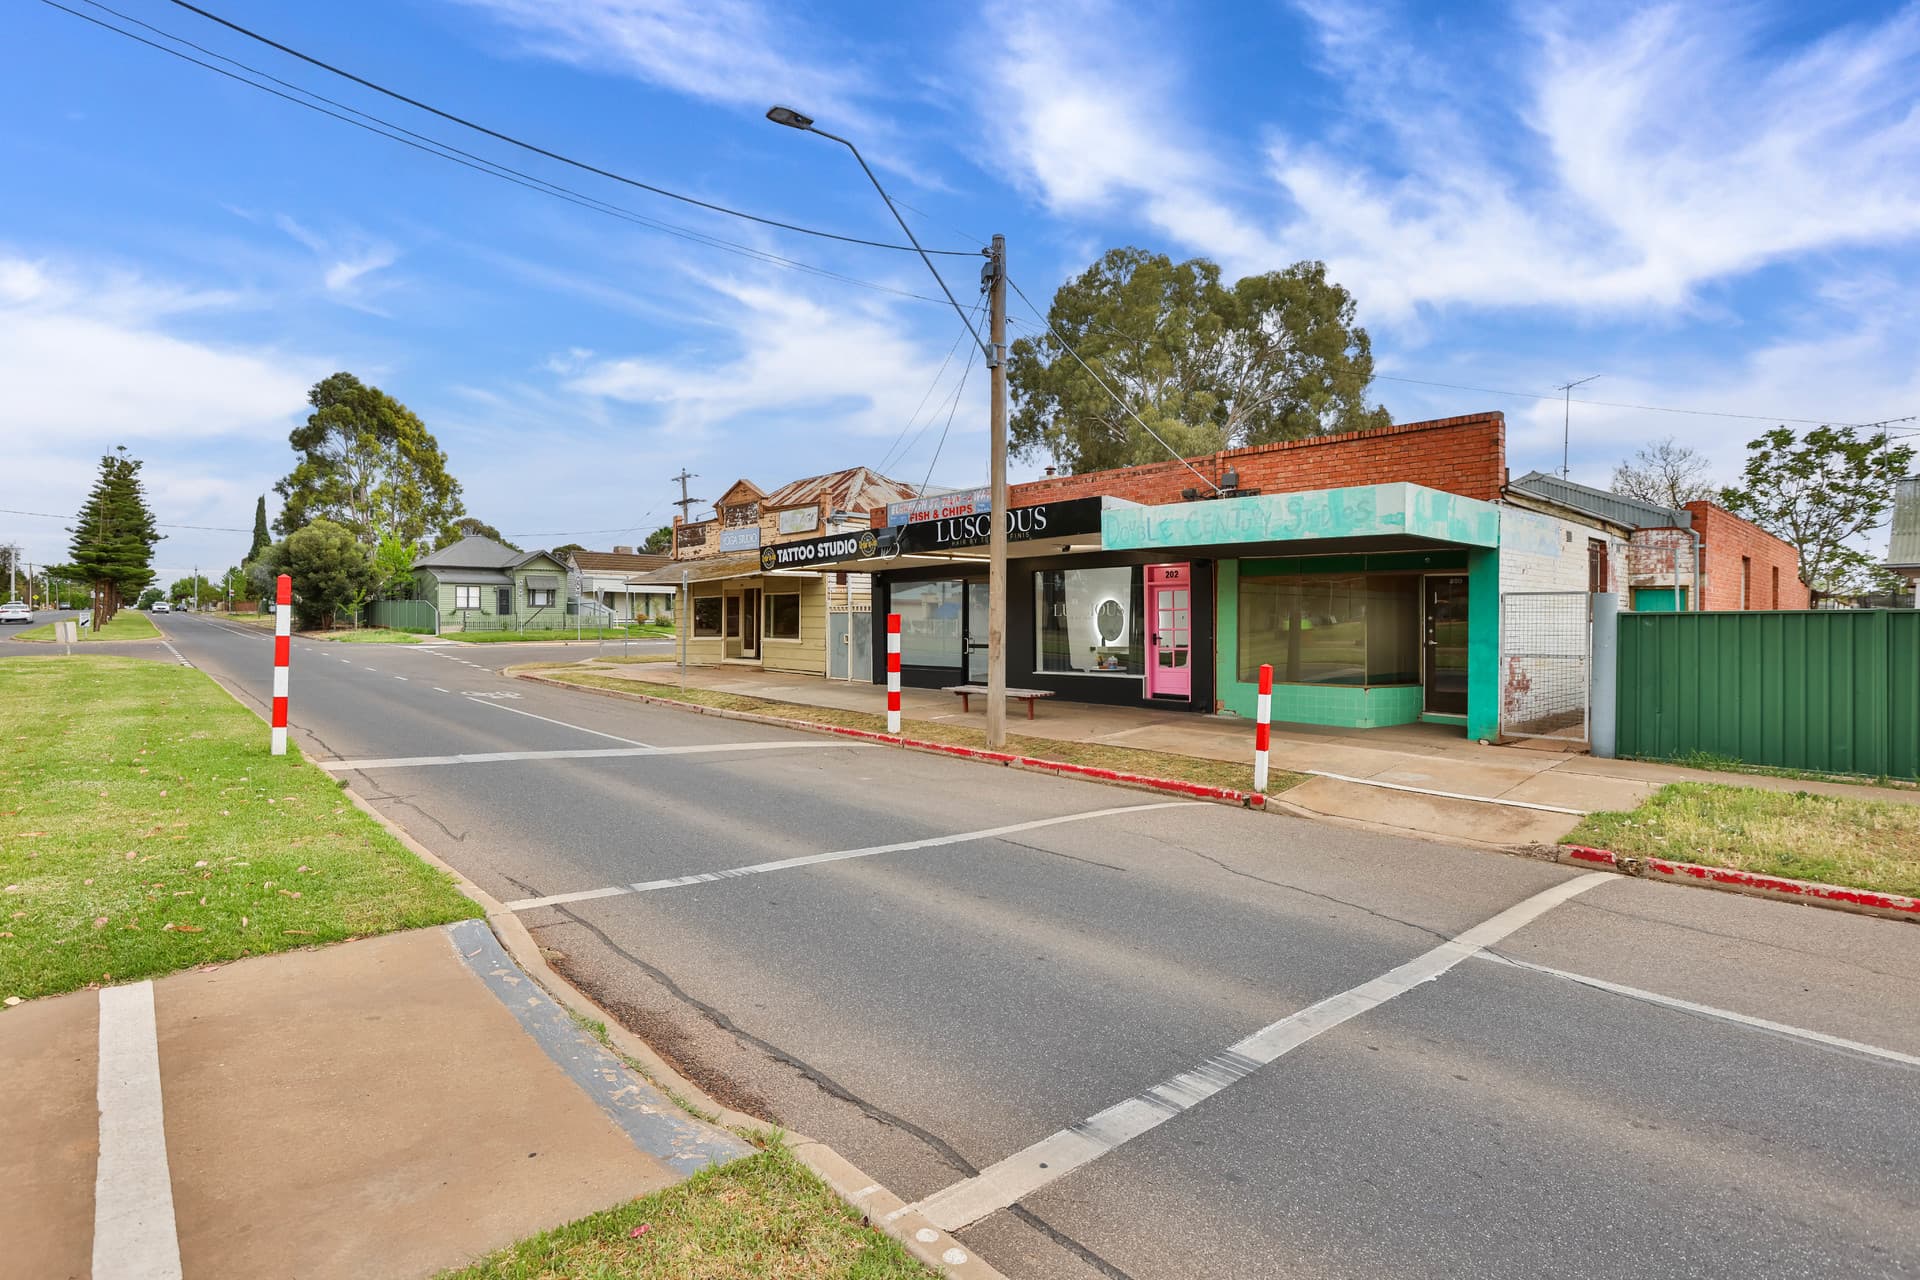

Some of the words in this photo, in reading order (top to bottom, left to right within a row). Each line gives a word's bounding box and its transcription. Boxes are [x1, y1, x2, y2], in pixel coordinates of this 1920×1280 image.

[909, 511, 930, 523] FISH
[933, 508, 939, 520] &
[942, 504, 973, 518] CHIPS
[936, 506, 1047, 543] LUSCOUS
[777, 544, 814, 563] TATTOO
[817, 539, 857, 558] STUDIO
[1165, 570, 1179, 579] 202
